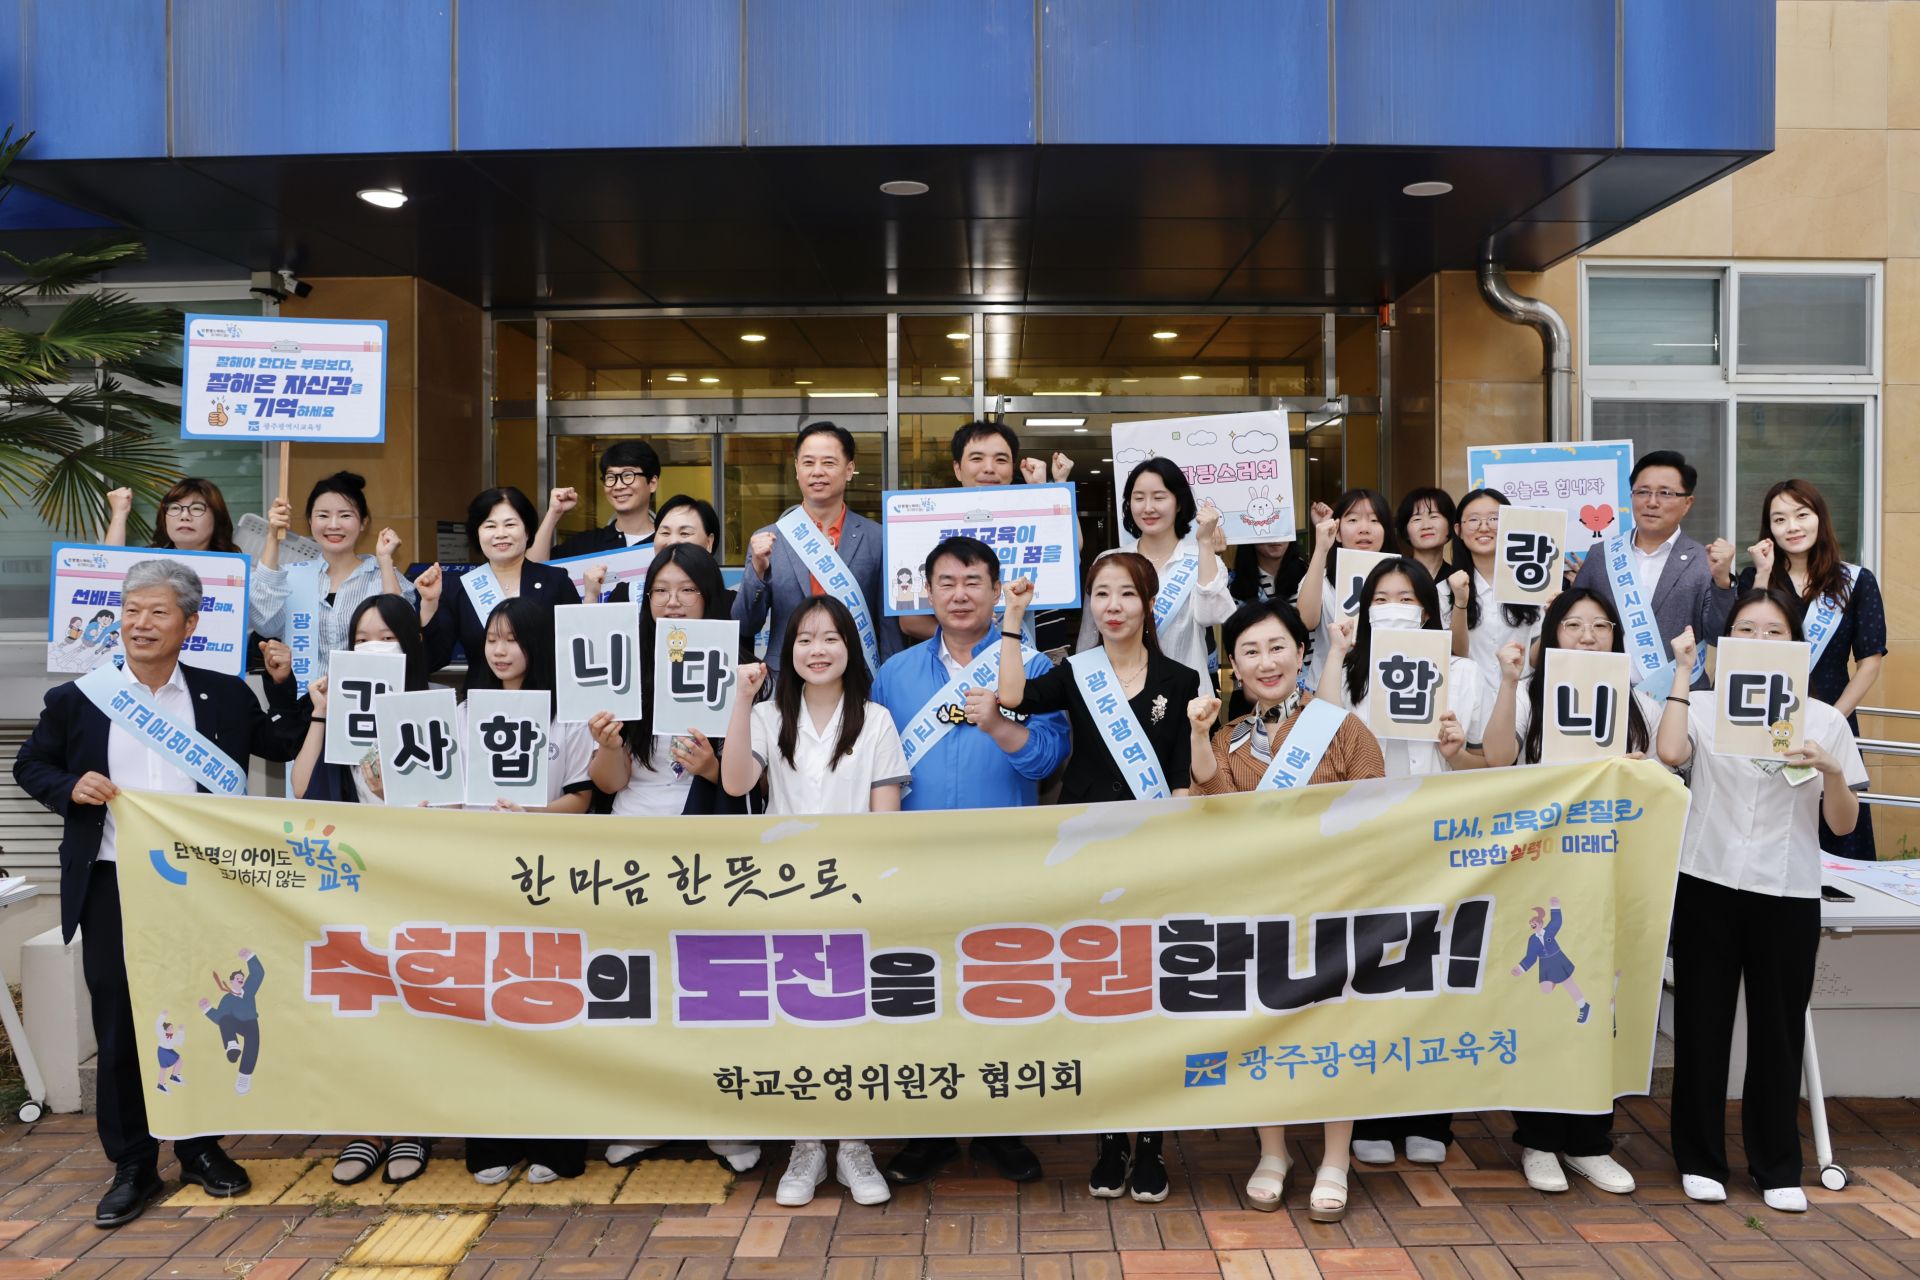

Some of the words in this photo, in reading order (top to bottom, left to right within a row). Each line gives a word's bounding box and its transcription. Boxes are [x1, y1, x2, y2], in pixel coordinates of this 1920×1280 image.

[206, 373, 276, 394] 잘해온
[283, 375, 363, 396] 자신감을
[216, 356, 255, 370] 잘해야
[258, 357, 297, 370] 한다는
[301, 359, 354, 373] 부담보다,
[234, 404, 248, 416] 꼭
[254, 398, 335, 418] 기억하세요
[1503, 480, 1550, 500] 오늘도
[1556, 477, 1605, 498] 힘내자
[1023, 545, 1063, 564] 꿈을
[1507, 533, 1553, 585] 랑
[1611, 535, 1660, 669] 주광역시교육청
[571, 633, 623, 687] 니
[671, 650, 727, 703] 다
[1378, 654, 1436, 716] 합
[1556, 685, 1609, 739] 니
[1728, 673, 1791, 728] 다
[110, 689, 239, 793] 학교운영위원장
[393, 719, 449, 772] 사
[479, 715, 539, 779] 합
[1434, 817, 1483, 841] 다시,
[1490, 802, 1562, 836] 교육의
[1566, 799, 1643, 824] 본질로
[241, 848, 292, 867] 아이도
[286, 837, 337, 867] 광주
[1450, 844, 1507, 868] 다양한
[1562, 829, 1619, 853] 미래다
[276, 869, 307, 888] 않는
[317, 863, 361, 892] 교육
[511, 854, 555, 906] 한
[569, 859, 651, 907] 마음
[667, 853, 712, 906] 한
[309, 927, 652, 1025] 수험생의
[675, 932, 937, 1023] 도전을
[961, 899, 1491, 1020] 응원합니다!
[712, 1062, 965, 1101] 학교운영위원장
[978, 1060, 1082, 1099] 협의회
[1237, 1029, 1518, 1081] 광주광역시교육청
